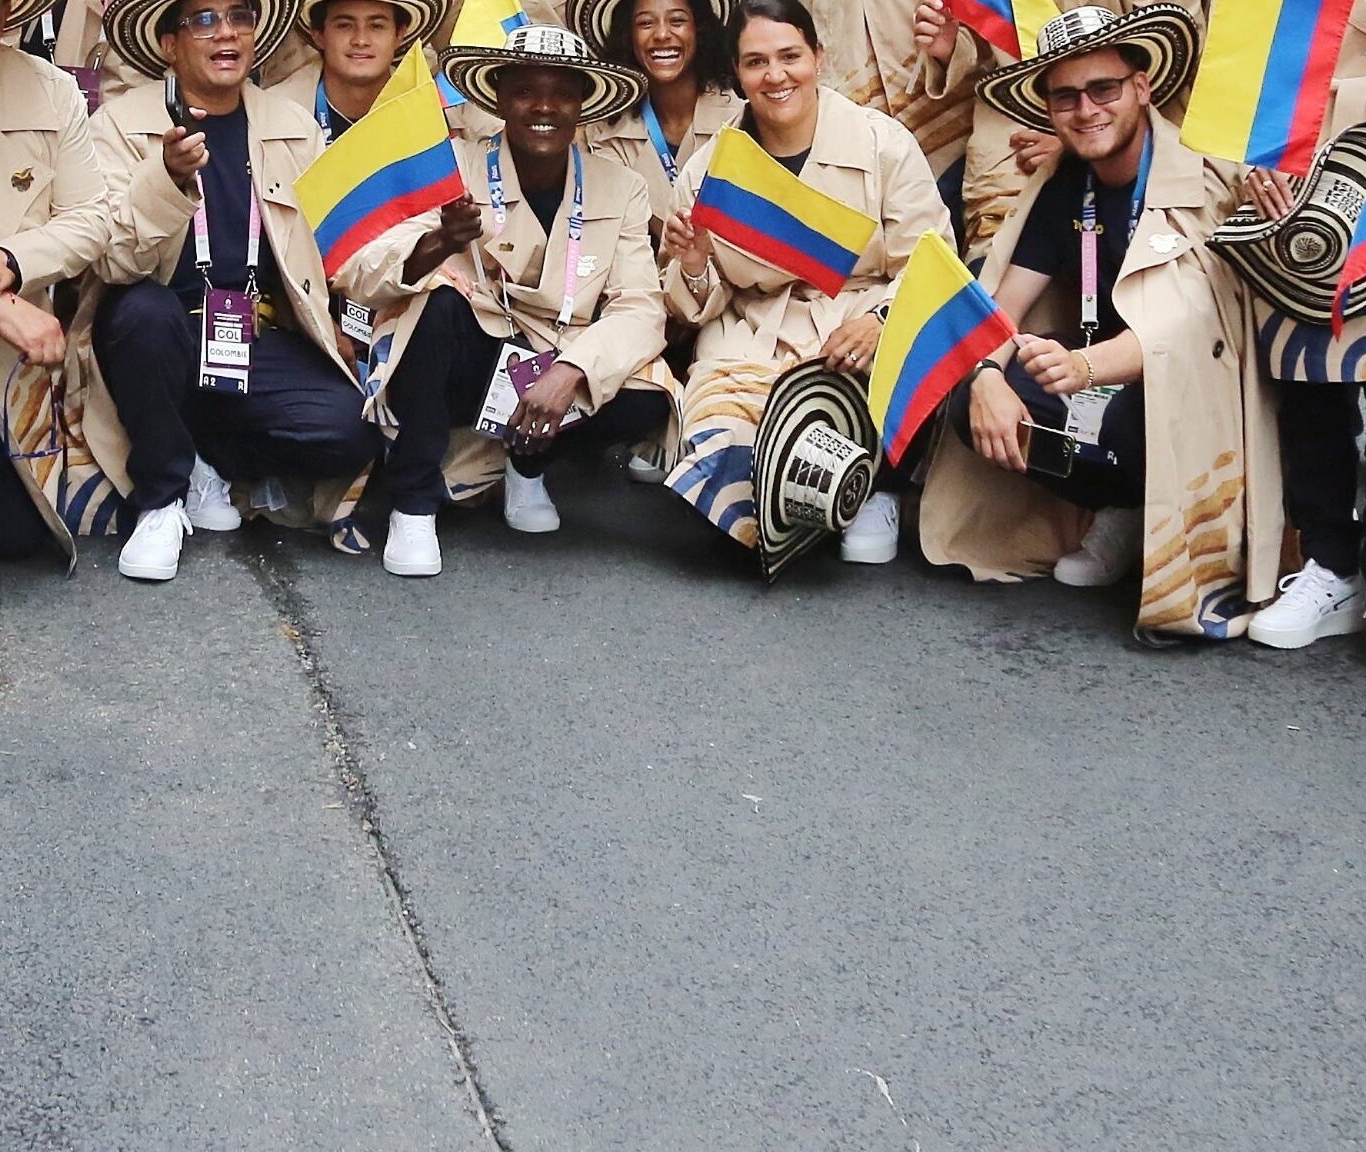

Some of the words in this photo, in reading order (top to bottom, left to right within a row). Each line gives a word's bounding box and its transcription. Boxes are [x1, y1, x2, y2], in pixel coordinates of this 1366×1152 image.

[349, 307, 367, 322] COL
[218, 330, 239, 340] COL
[210, 348, 247, 359] COLOMBIE
